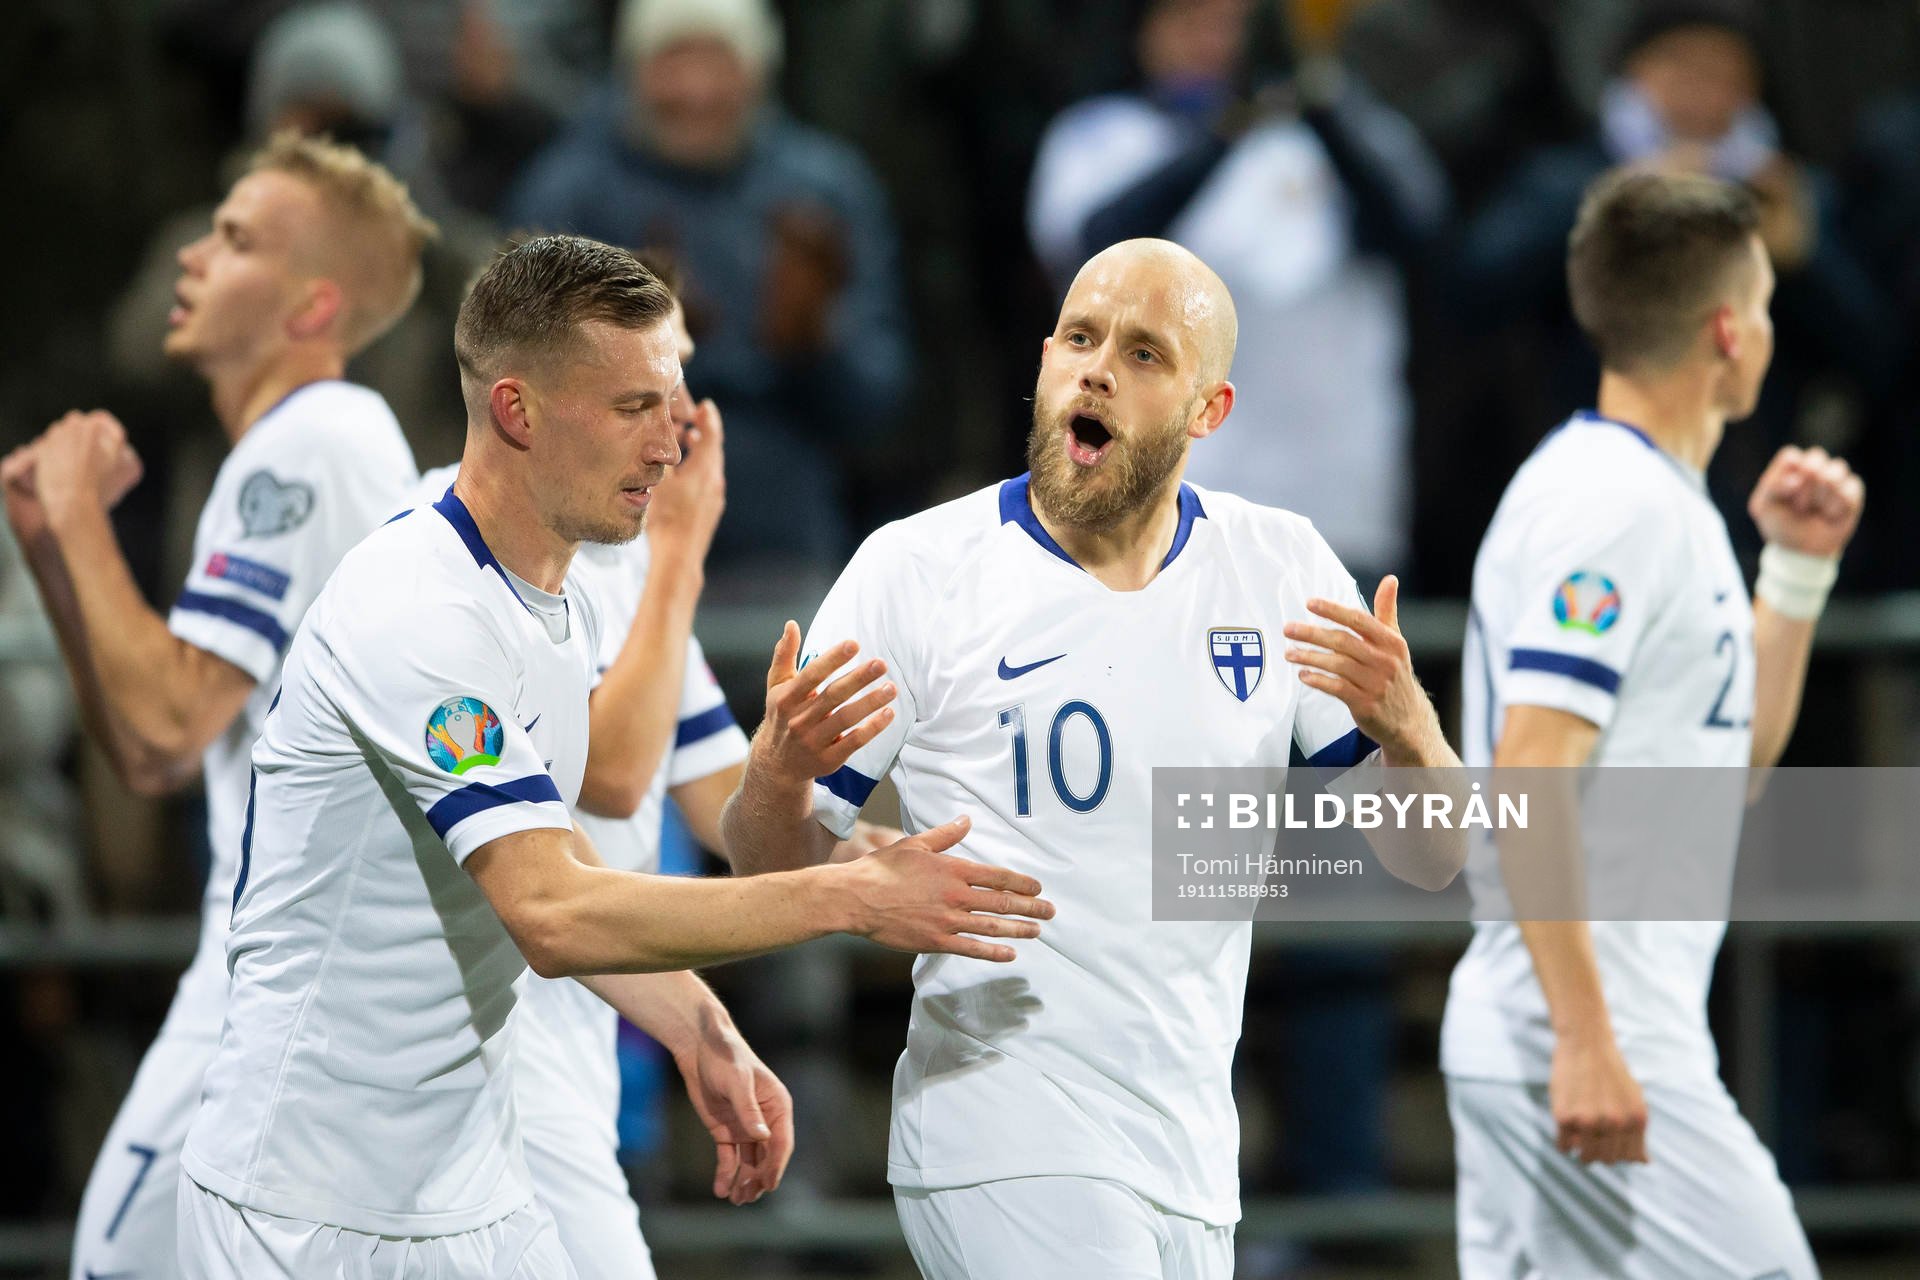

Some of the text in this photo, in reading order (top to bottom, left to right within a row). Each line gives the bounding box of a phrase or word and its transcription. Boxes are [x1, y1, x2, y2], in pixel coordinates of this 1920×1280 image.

[1703, 629, 1750, 729] 2
[998, 699, 1114, 818] 10
[105, 1143, 158, 1241] 7
